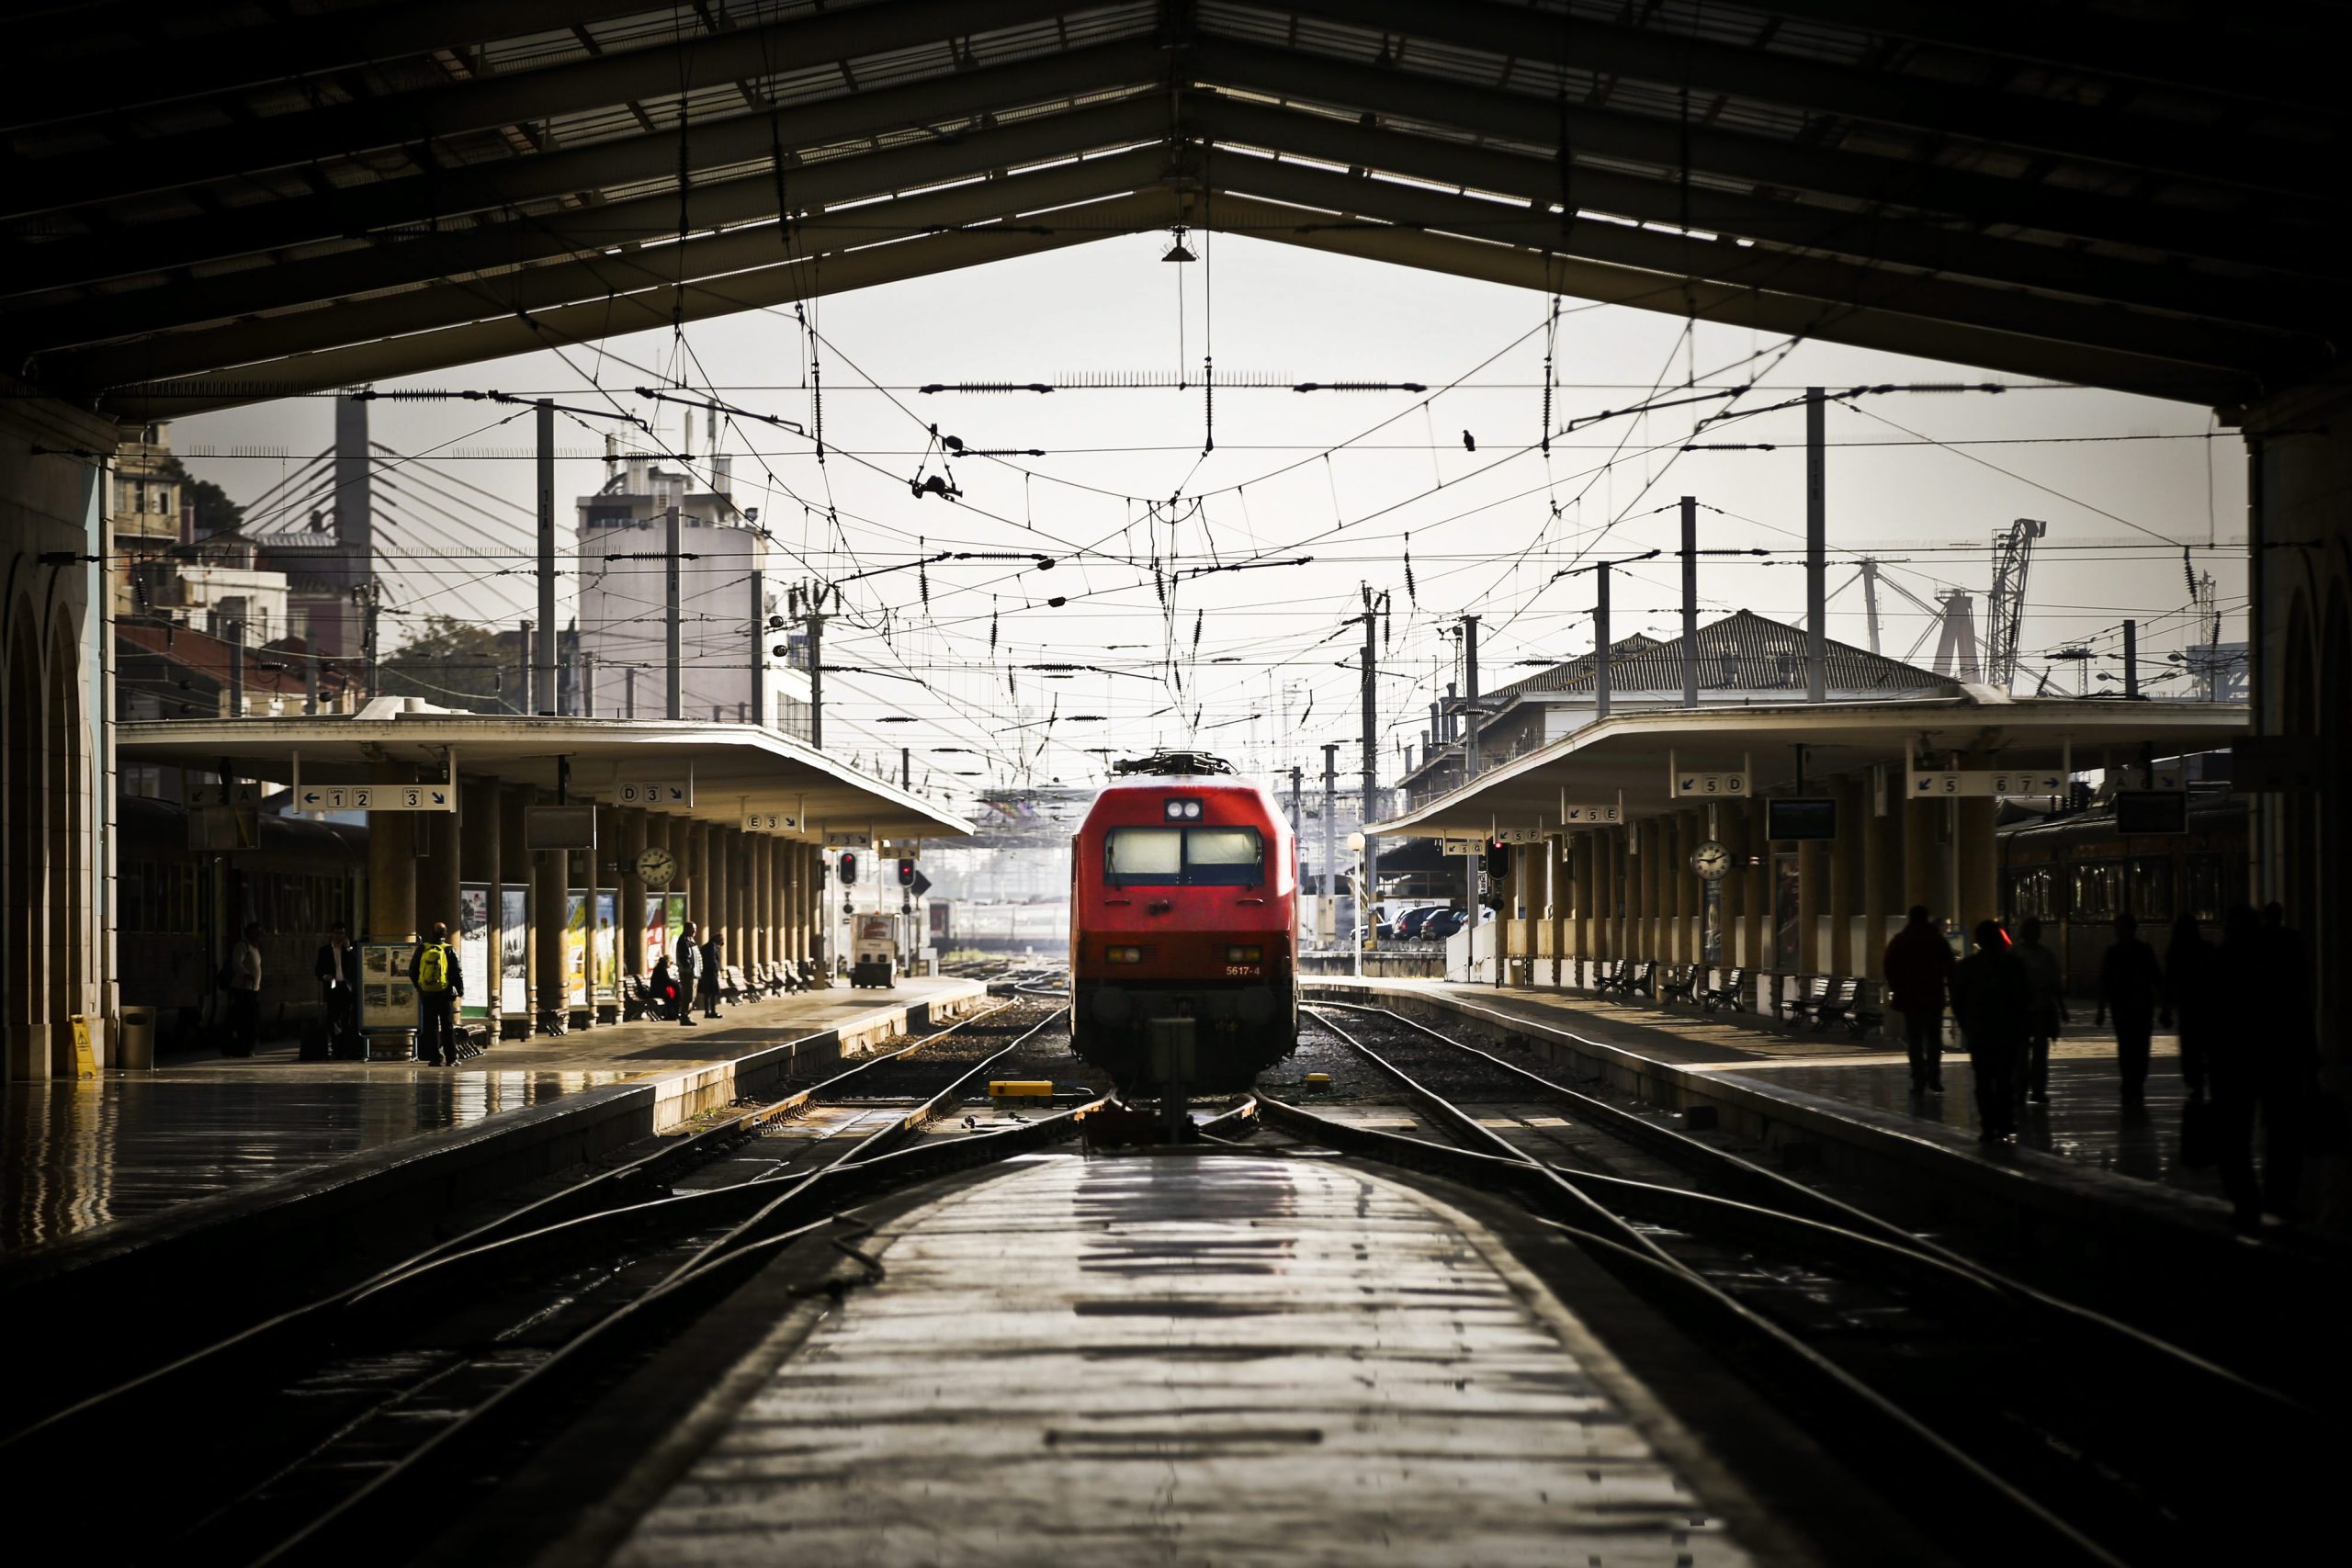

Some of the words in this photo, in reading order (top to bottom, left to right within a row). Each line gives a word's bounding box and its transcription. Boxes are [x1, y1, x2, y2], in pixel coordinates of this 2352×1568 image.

[1707, 781, 1715, 791] 5
[1730, 779, 1739, 789] D
[1946, 781, 1955, 792] 5
[1997, 780, 2007, 791] 6
[2022, 780, 2031, 791] 7
[240, 789, 250, 802] A
[334, 795, 340, 806] 1
[358, 794, 368, 806] 2
[409, 794, 417, 806] 3
[625, 788, 635, 799] D
[649, 789, 657, 801] 3
[1590, 811, 1596, 820] 5
[1608, 809, 1614, 818] E
[751, 818, 759, 827] E
[769, 818, 776, 828] 3
[1516, 832, 1521, 840] 5
[1227, 966, 1261, 976] 5617-4
